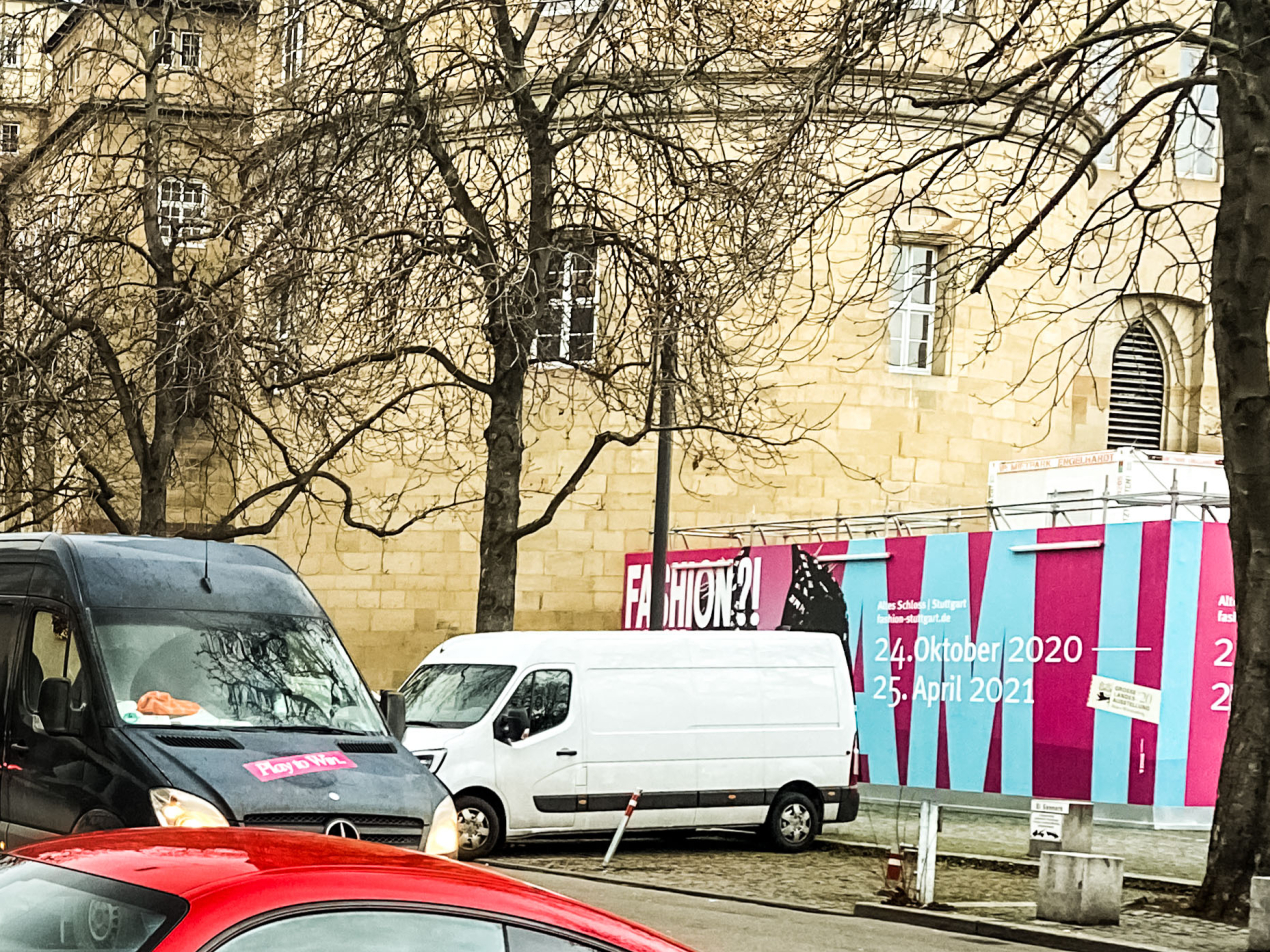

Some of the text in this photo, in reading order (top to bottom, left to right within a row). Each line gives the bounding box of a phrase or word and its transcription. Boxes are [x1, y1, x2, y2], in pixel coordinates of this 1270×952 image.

[877, 601, 896, 610] Altes
[897, 599, 926, 610] Schloss
[931, 599, 967, 611] Stuttgart
[876, 613, 951, 625] fashion-stuttgart.de
[1008, 635, 1083, 663] 2020
[873, 675, 1035, 708] 25. April 2021
[255, 761, 294, 776] Play
[292, 760, 310, 770] to
